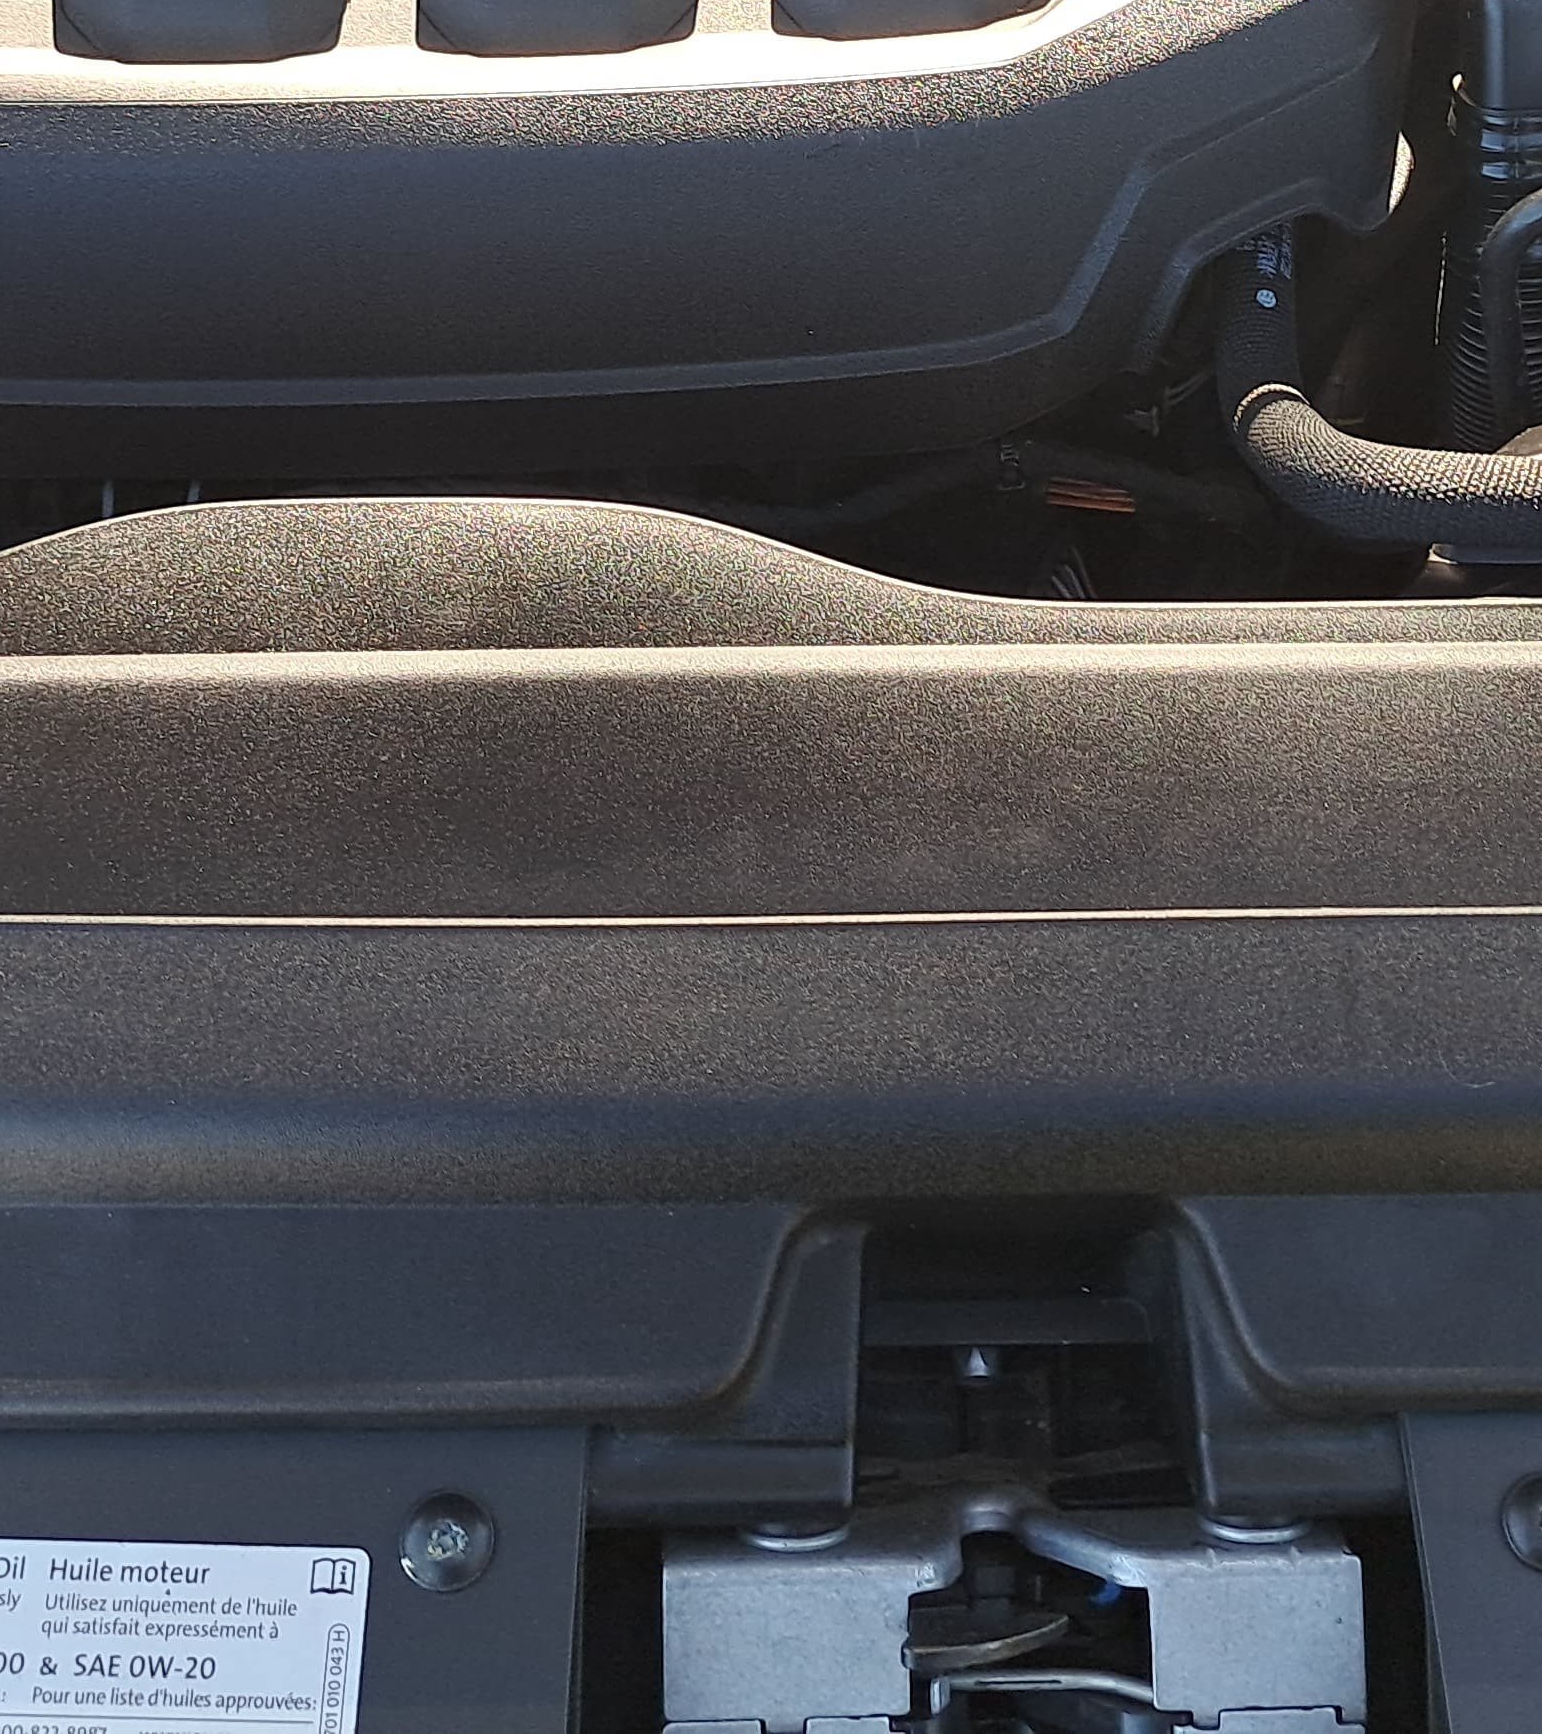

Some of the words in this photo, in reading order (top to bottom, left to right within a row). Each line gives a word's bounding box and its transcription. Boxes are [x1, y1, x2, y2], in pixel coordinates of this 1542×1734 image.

[49, 1558, 113, 1583] Huile
[120, 1560, 211, 1585] moteur
[45, 1593, 107, 1612] Utilisez
[112, 1596, 216, 1618] uniquement
[221, 1596, 242, 1615] de
[247, 1597, 298, 1617] l'huile
[41, 1617, 69, 1637] qui
[72, 1618, 140, 1636] satisfait
[145, 1619, 264, 1641] expressément
[269, 1621, 279, 1639] à
[331, 1630, 348, 1641] H
[39, 1655, 58, 1676] &
[73, 1654, 121, 1678] SAE
[129, 1655, 216, 1680] 0W-20
[328, 1647, 346, 1675] 043
[32, 1686, 71, 1705] Pour
[74, 1690, 106, 1706] une
[110, 1687, 144, 1707] liste
[148, 1687, 211, 1708] d'huiles
[215, 1691, 317, 1713] approuvées:
[325, 1680, 342, 1707] 010
